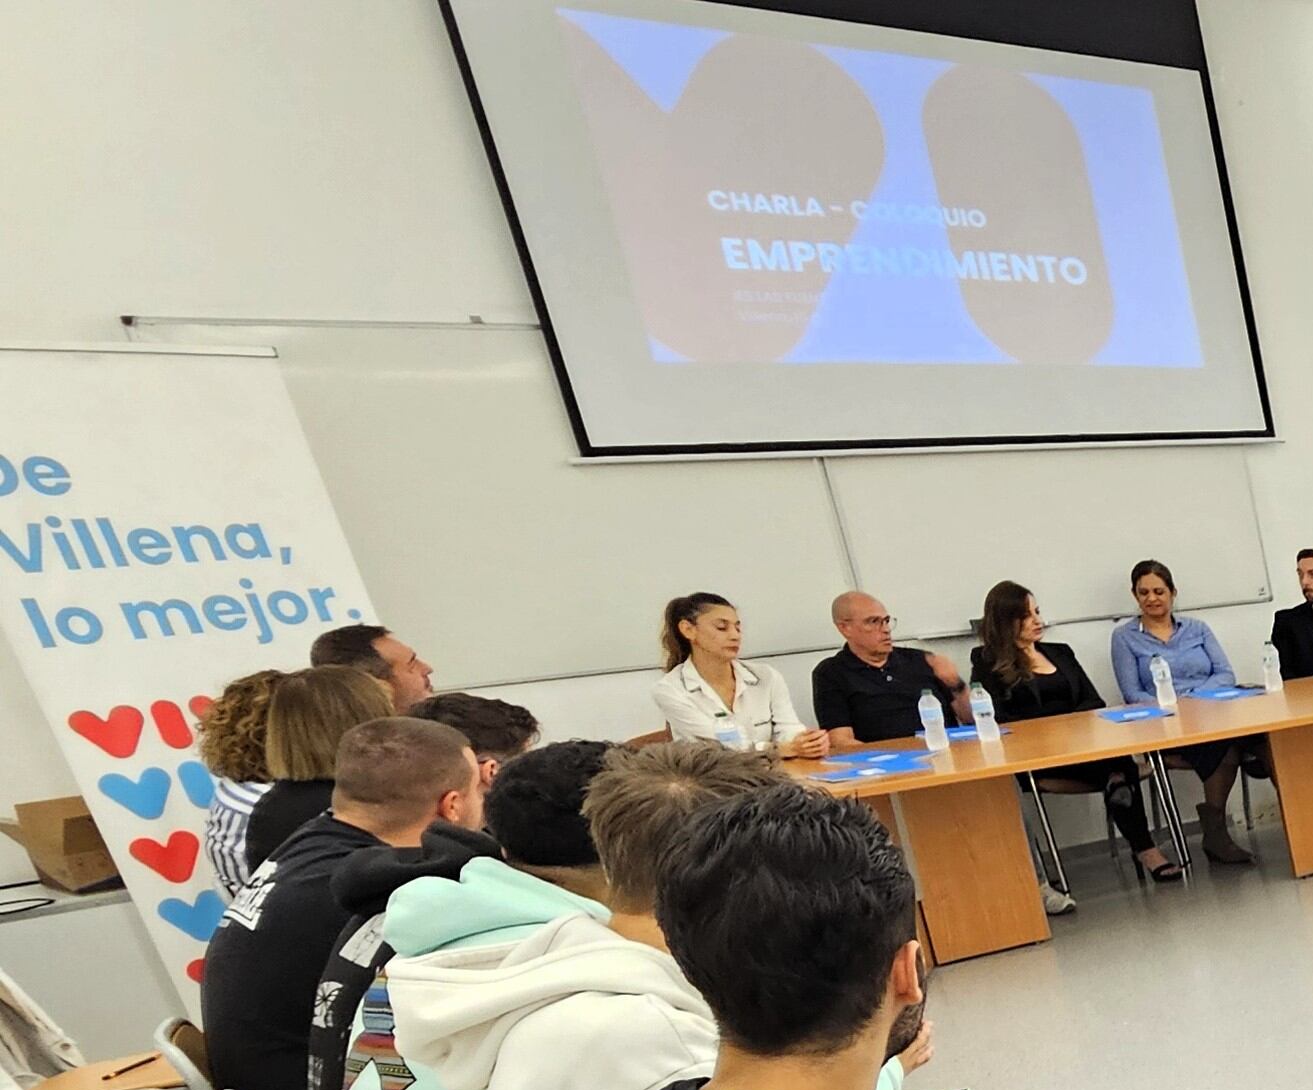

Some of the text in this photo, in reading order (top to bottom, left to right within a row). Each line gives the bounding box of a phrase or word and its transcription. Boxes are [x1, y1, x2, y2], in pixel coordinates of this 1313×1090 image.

[707, 190, 825, 217] CHARLA
[850, 200, 987, 229] COLOQUIO
[720, 237, 1088, 286] EMPRENDIMIENTO
[0, 515, 292, 573] Villena,
[20, 578, 362, 648] lo mejor.
